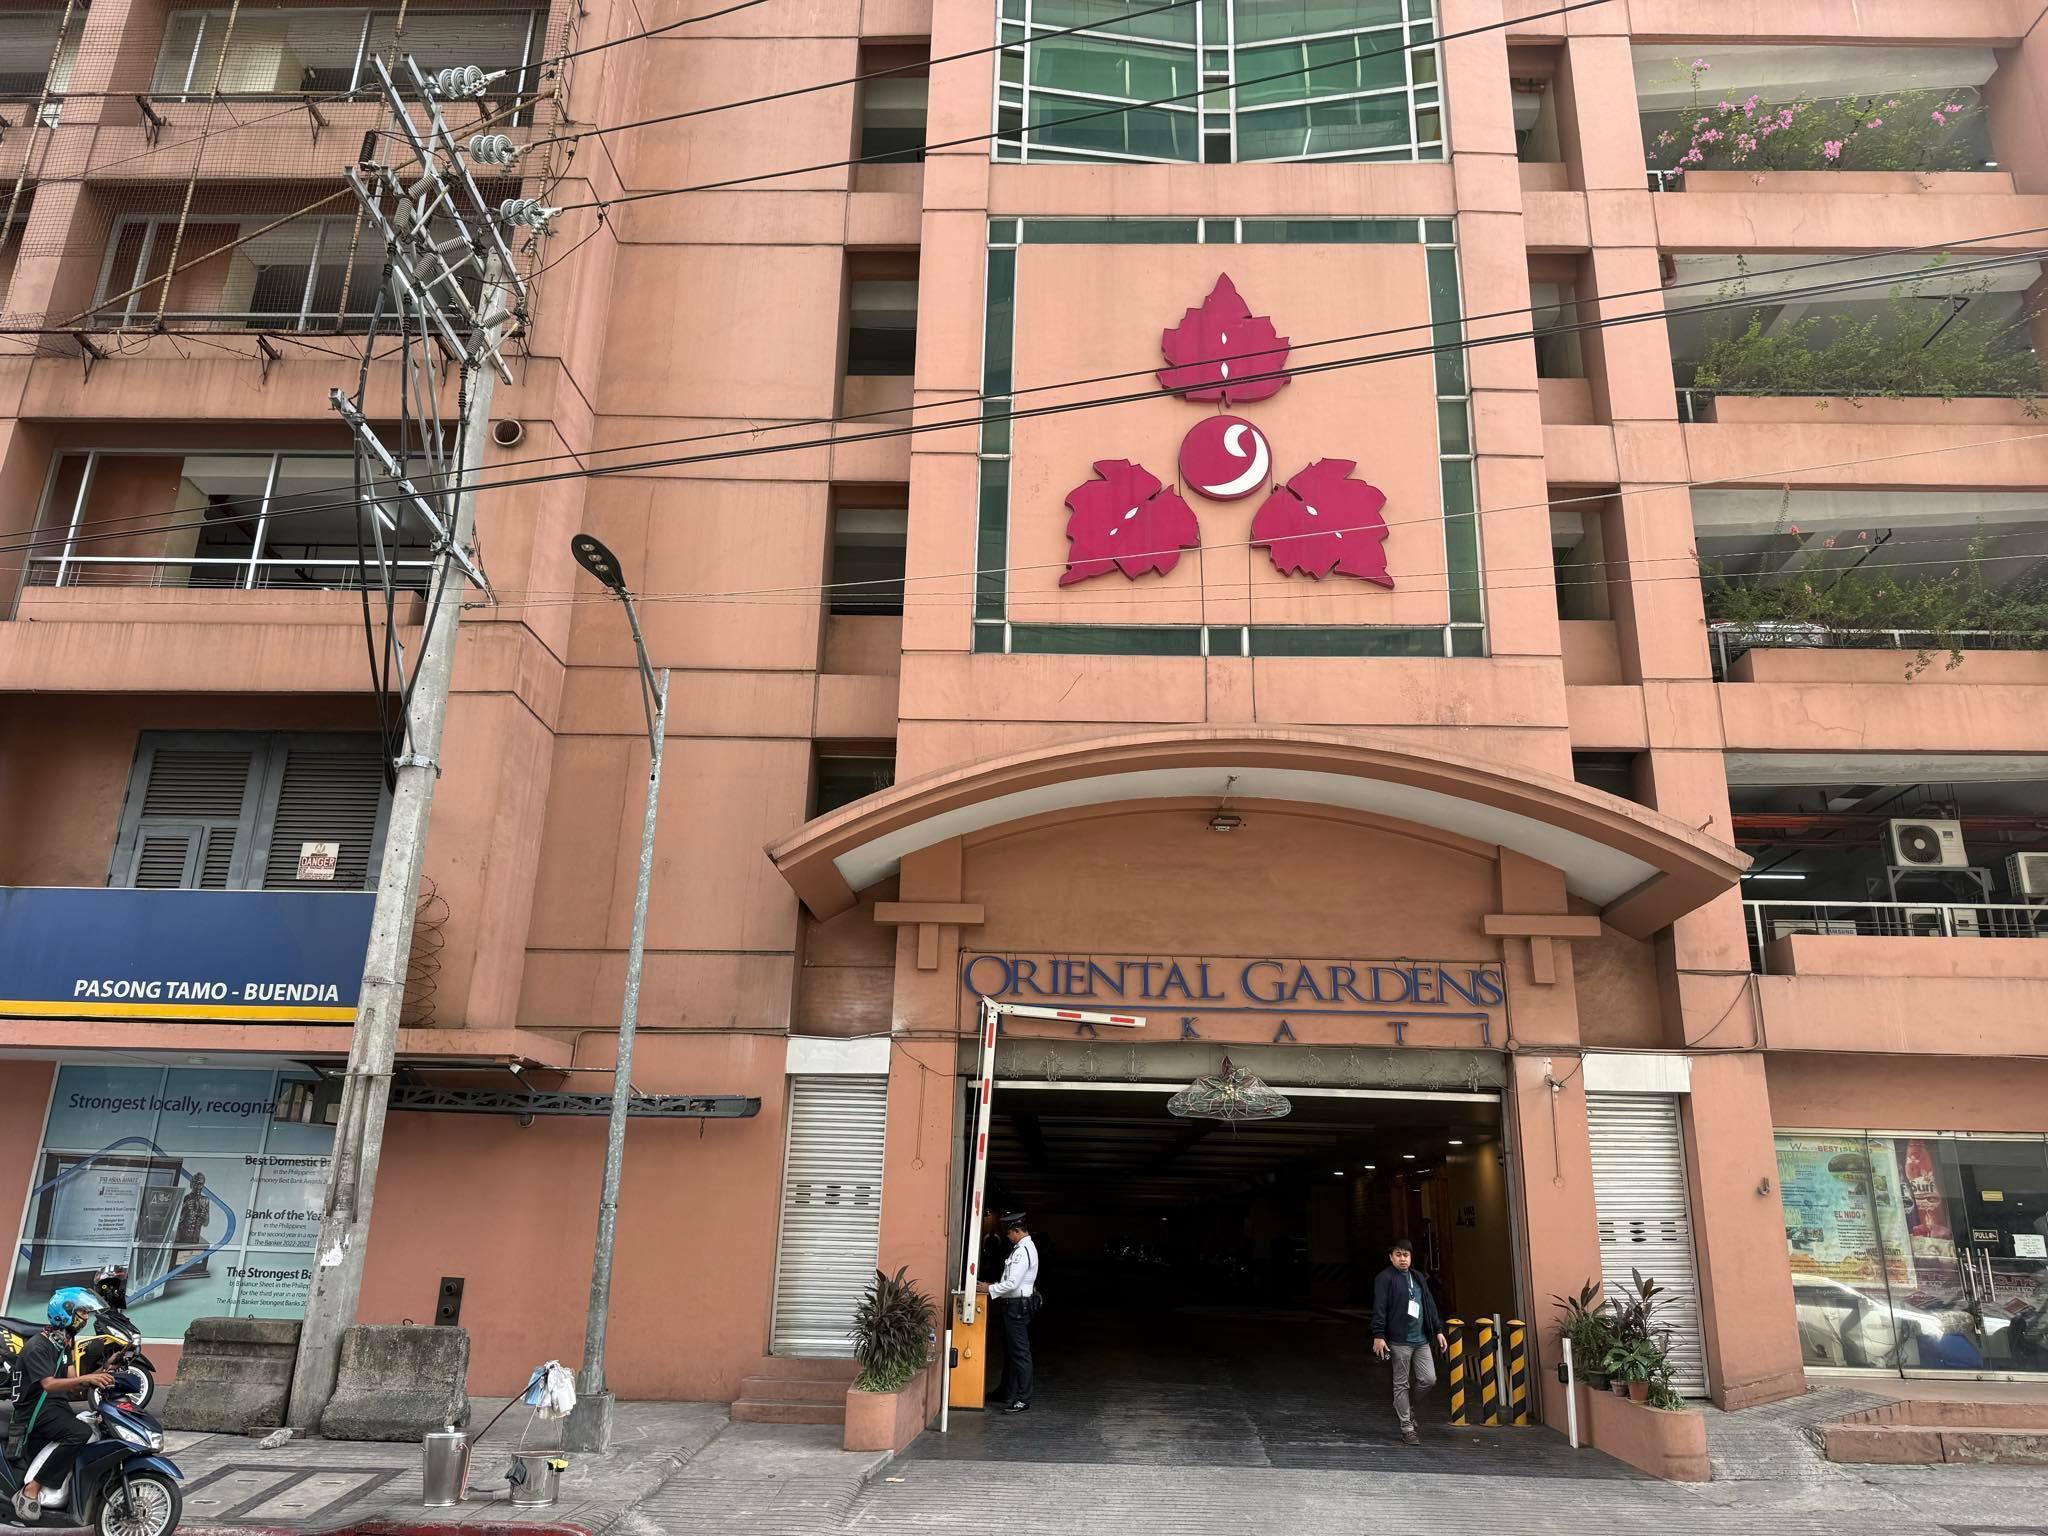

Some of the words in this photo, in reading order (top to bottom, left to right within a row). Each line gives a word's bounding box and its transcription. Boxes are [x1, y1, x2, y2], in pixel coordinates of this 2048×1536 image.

[301, 857, 335, 867] DANGER
[964, 956, 1225, 1000] ORIENTAL
[1241, 961, 1504, 1006] GARDENS
[73, 979, 161, 999] PASONG
[166, 981, 228, 1000] TAMO
[243, 983, 339, 1002] BUENDIA
[69, 1093, 146, 1113] Strongest
[149, 1095, 203, 1116] locally,
[206, 1100, 275, 1117] recogniz
[245, 1155, 268, 1166] Best
[269, 1156, 319, 1167] Domestic
[1911, 1181, 1935, 1193] Surf
[246, 1209, 273, 1220] Bank
[274, 1209, 287, 1220] of
[287, 1210, 305, 1221] the
[306, 1211, 323, 1222] Yea
[226, 1267, 246, 1278] The
[247, 1267, 300, 1281] Strongest
